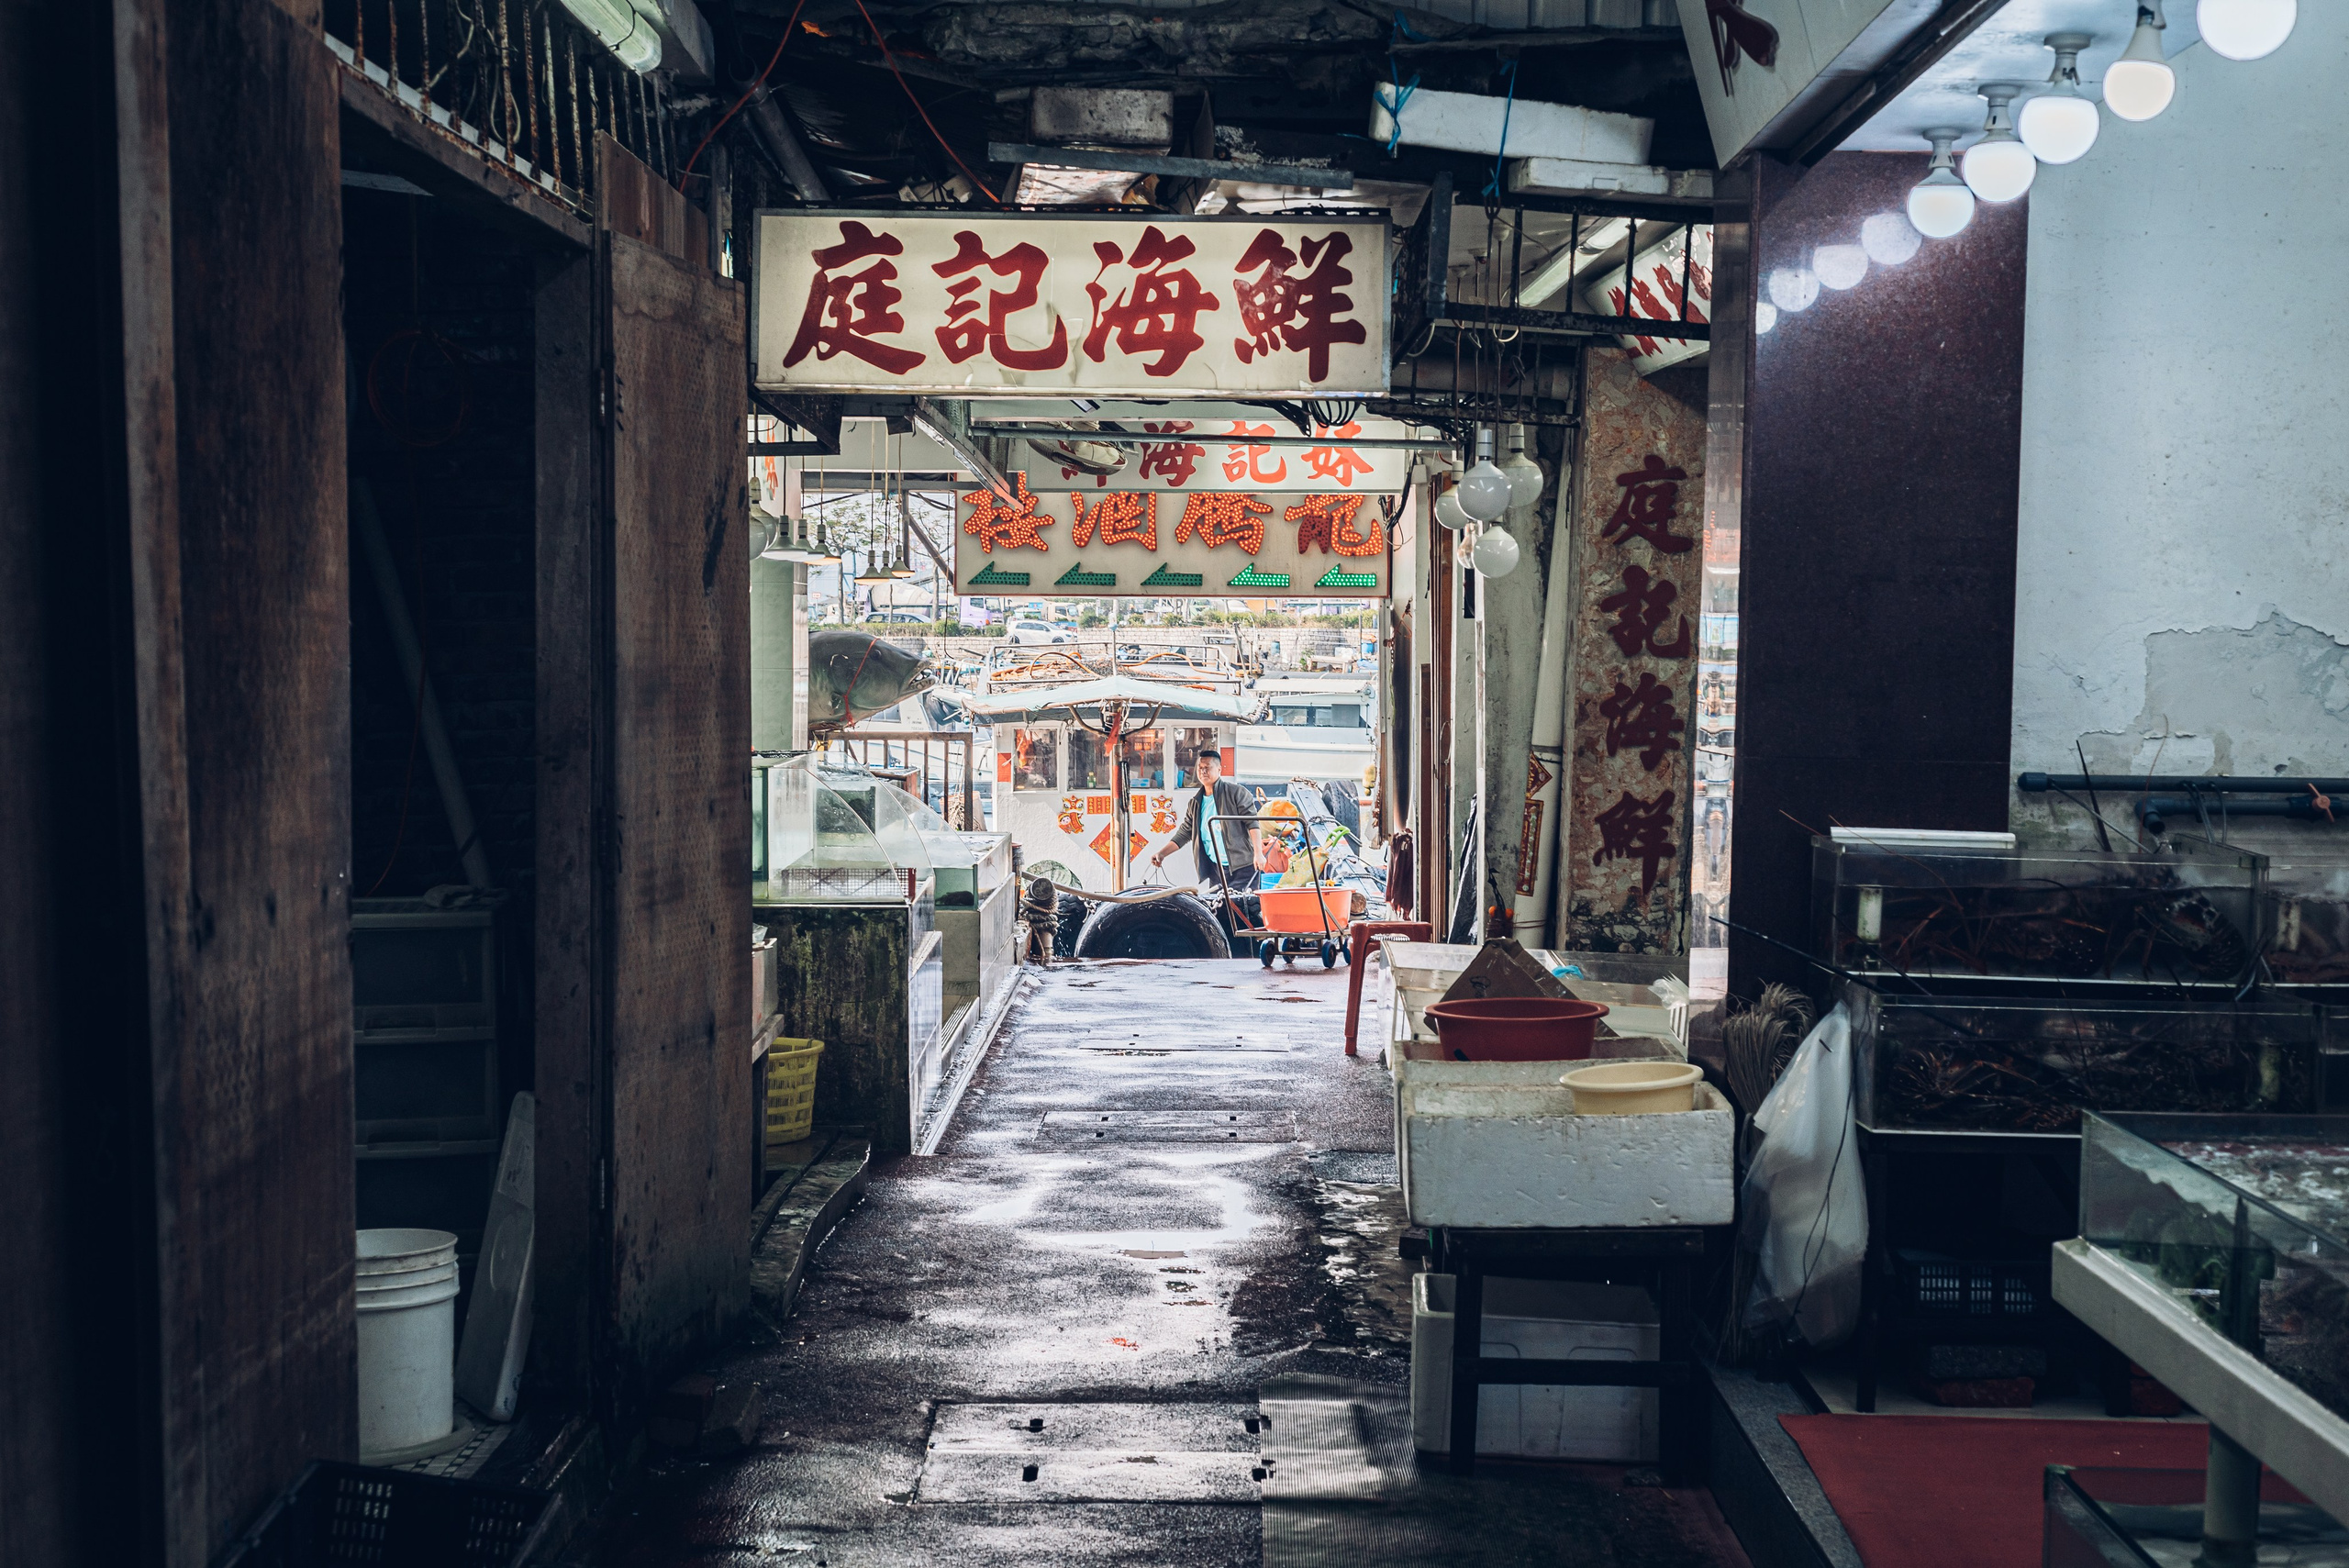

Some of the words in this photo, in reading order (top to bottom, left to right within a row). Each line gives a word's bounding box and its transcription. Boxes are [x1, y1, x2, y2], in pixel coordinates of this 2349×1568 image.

[783, 220, 1367, 383] 庭記海鮮
[1061, 420, 1375, 488] 妹記海
[1593, 455, 1695, 895] 庭記海鮮
